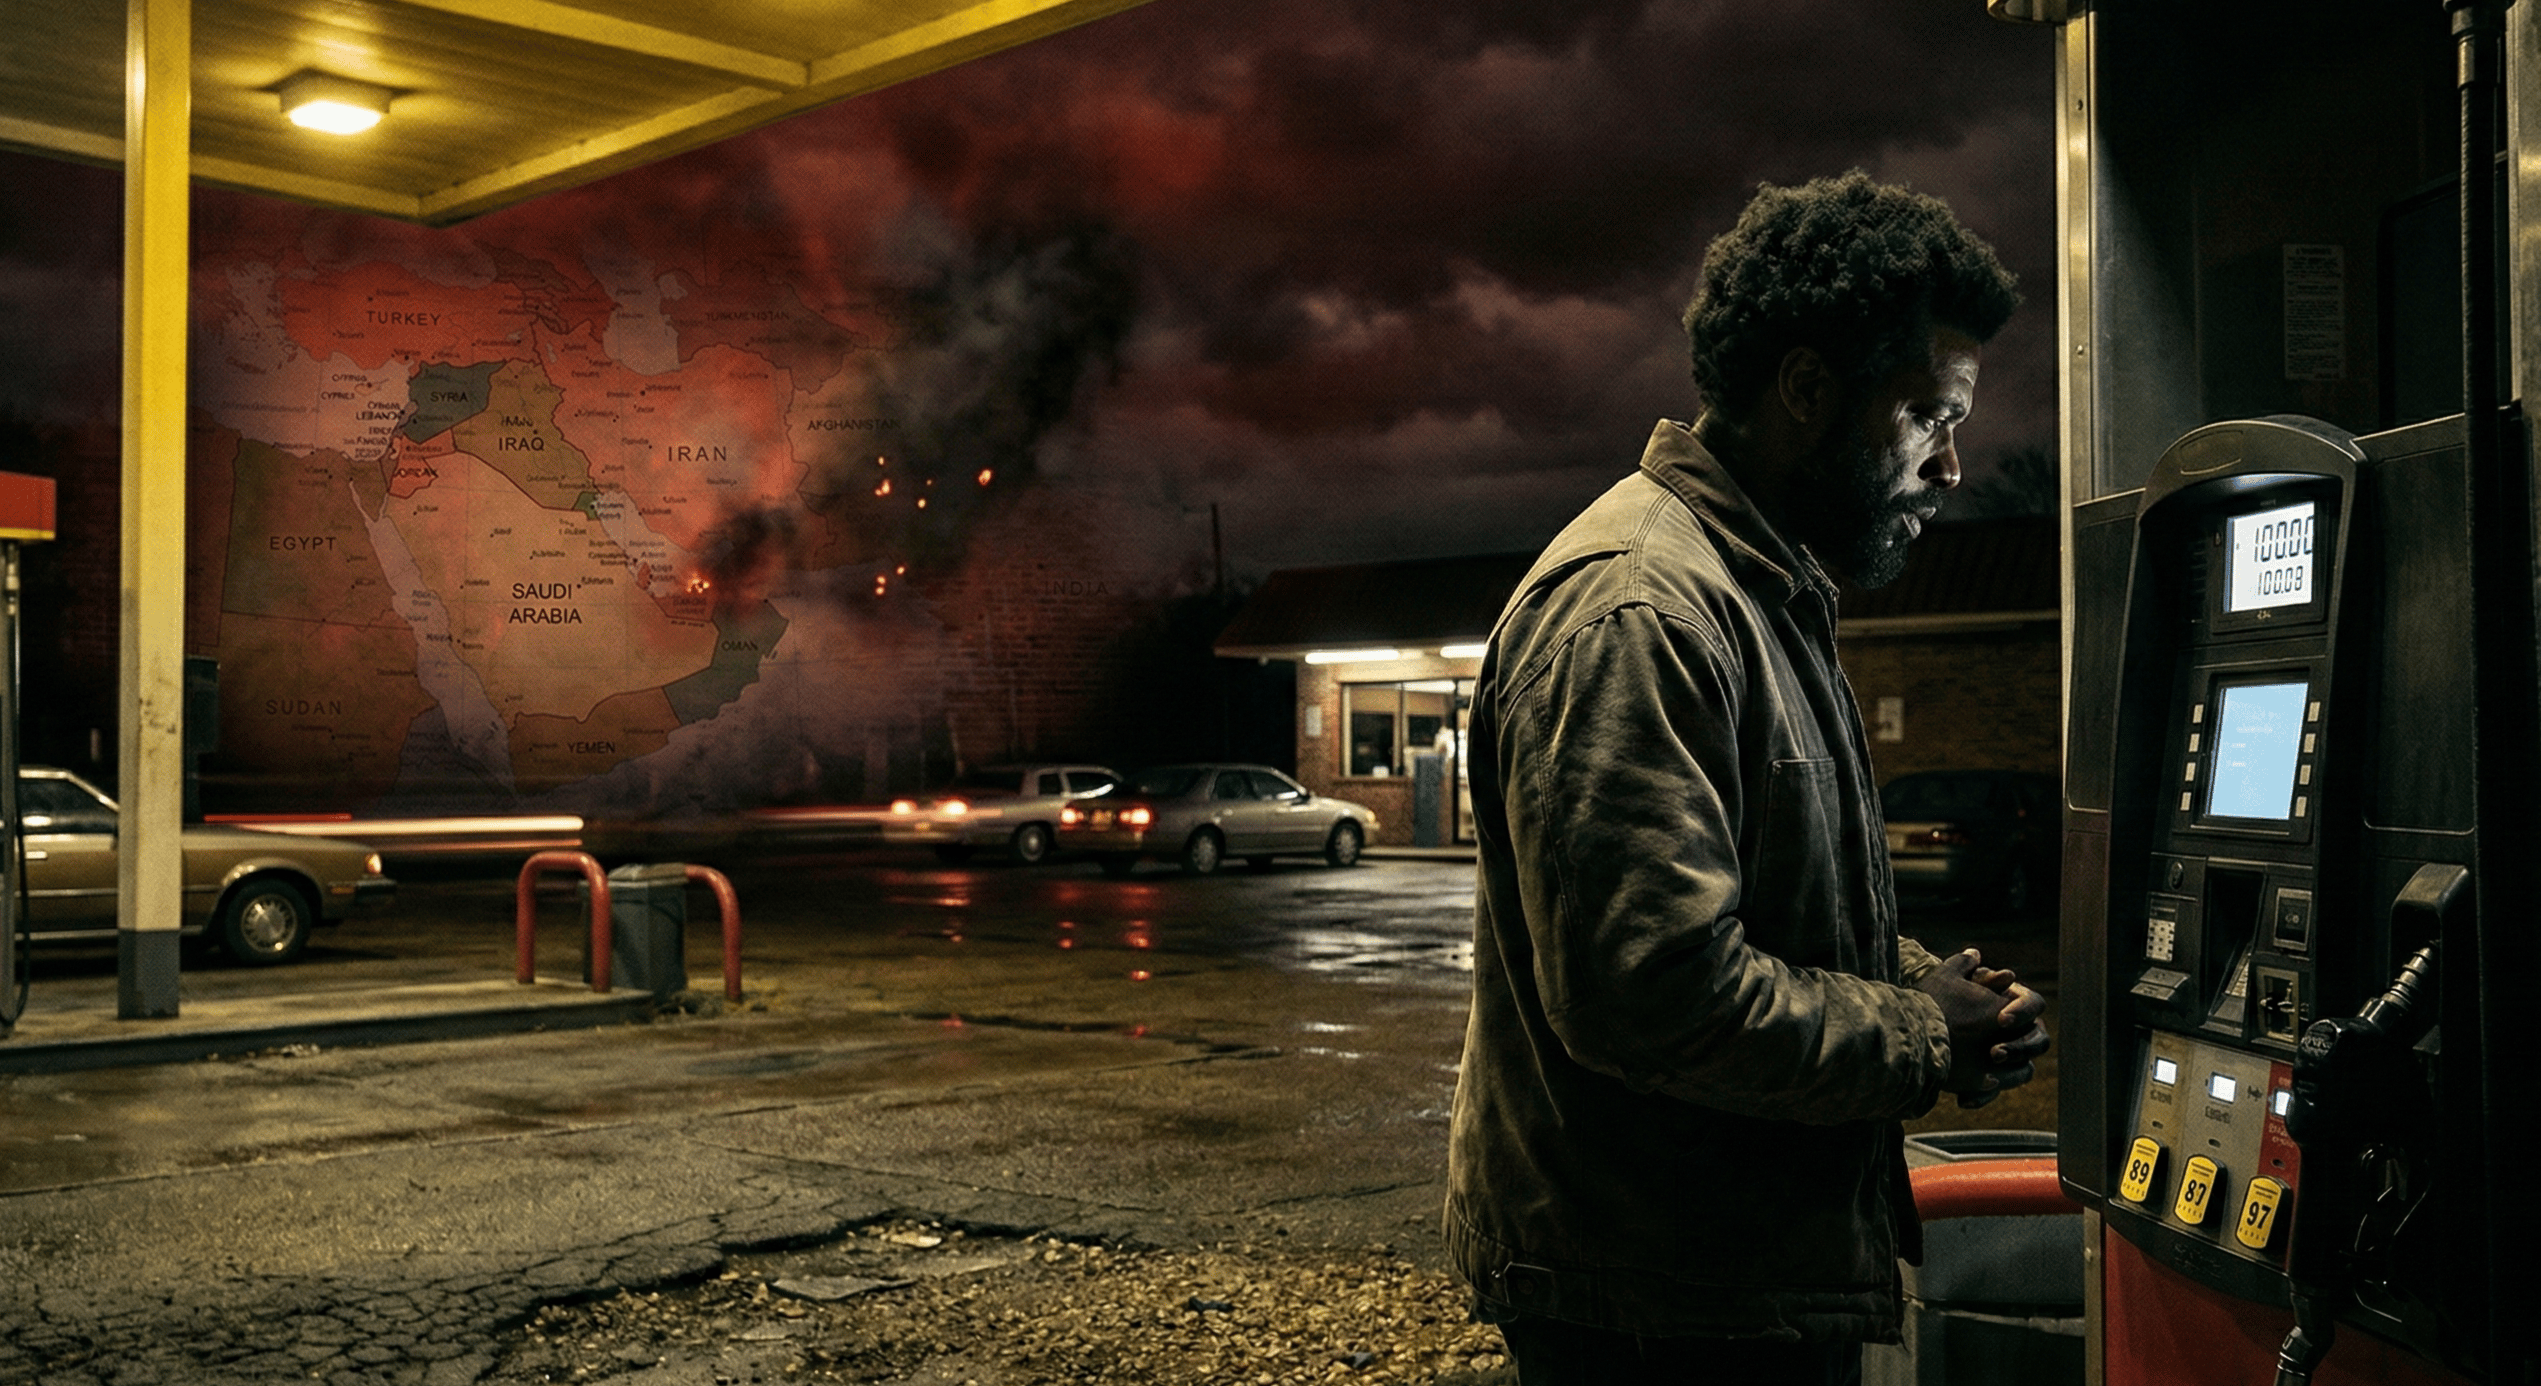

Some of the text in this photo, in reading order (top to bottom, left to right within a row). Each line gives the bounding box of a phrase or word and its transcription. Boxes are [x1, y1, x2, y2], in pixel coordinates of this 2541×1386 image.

[2129, 1159, 2150, 1184] 89
[2184, 1179, 2207, 1206] 87
[2246, 1201, 2271, 1229] 97
